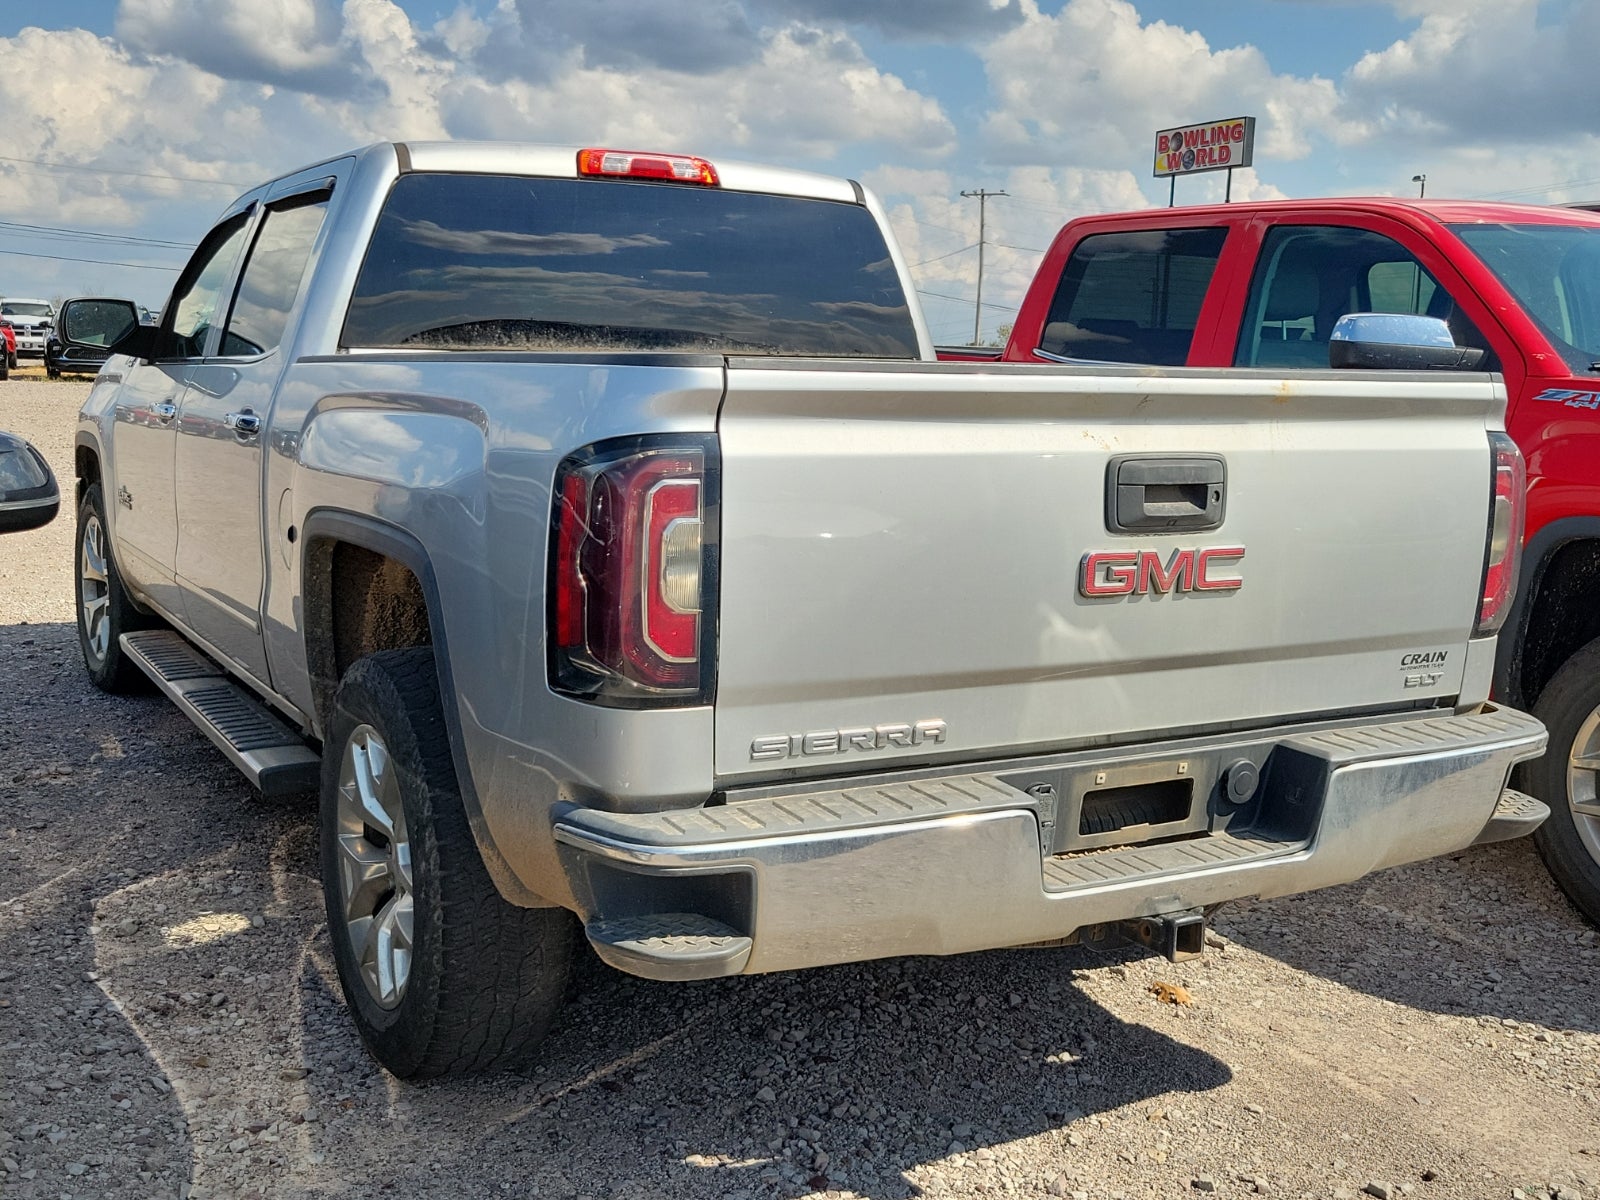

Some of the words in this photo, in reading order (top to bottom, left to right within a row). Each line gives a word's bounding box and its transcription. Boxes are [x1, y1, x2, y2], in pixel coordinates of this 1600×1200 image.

[1158, 123, 1244, 154] BOWLING
[1166, 145, 1231, 171] WORLD
[1079, 545, 1246, 598] GMC
[1401, 651, 1448, 666] CRAIN
[750, 718, 948, 760] SIERRA
